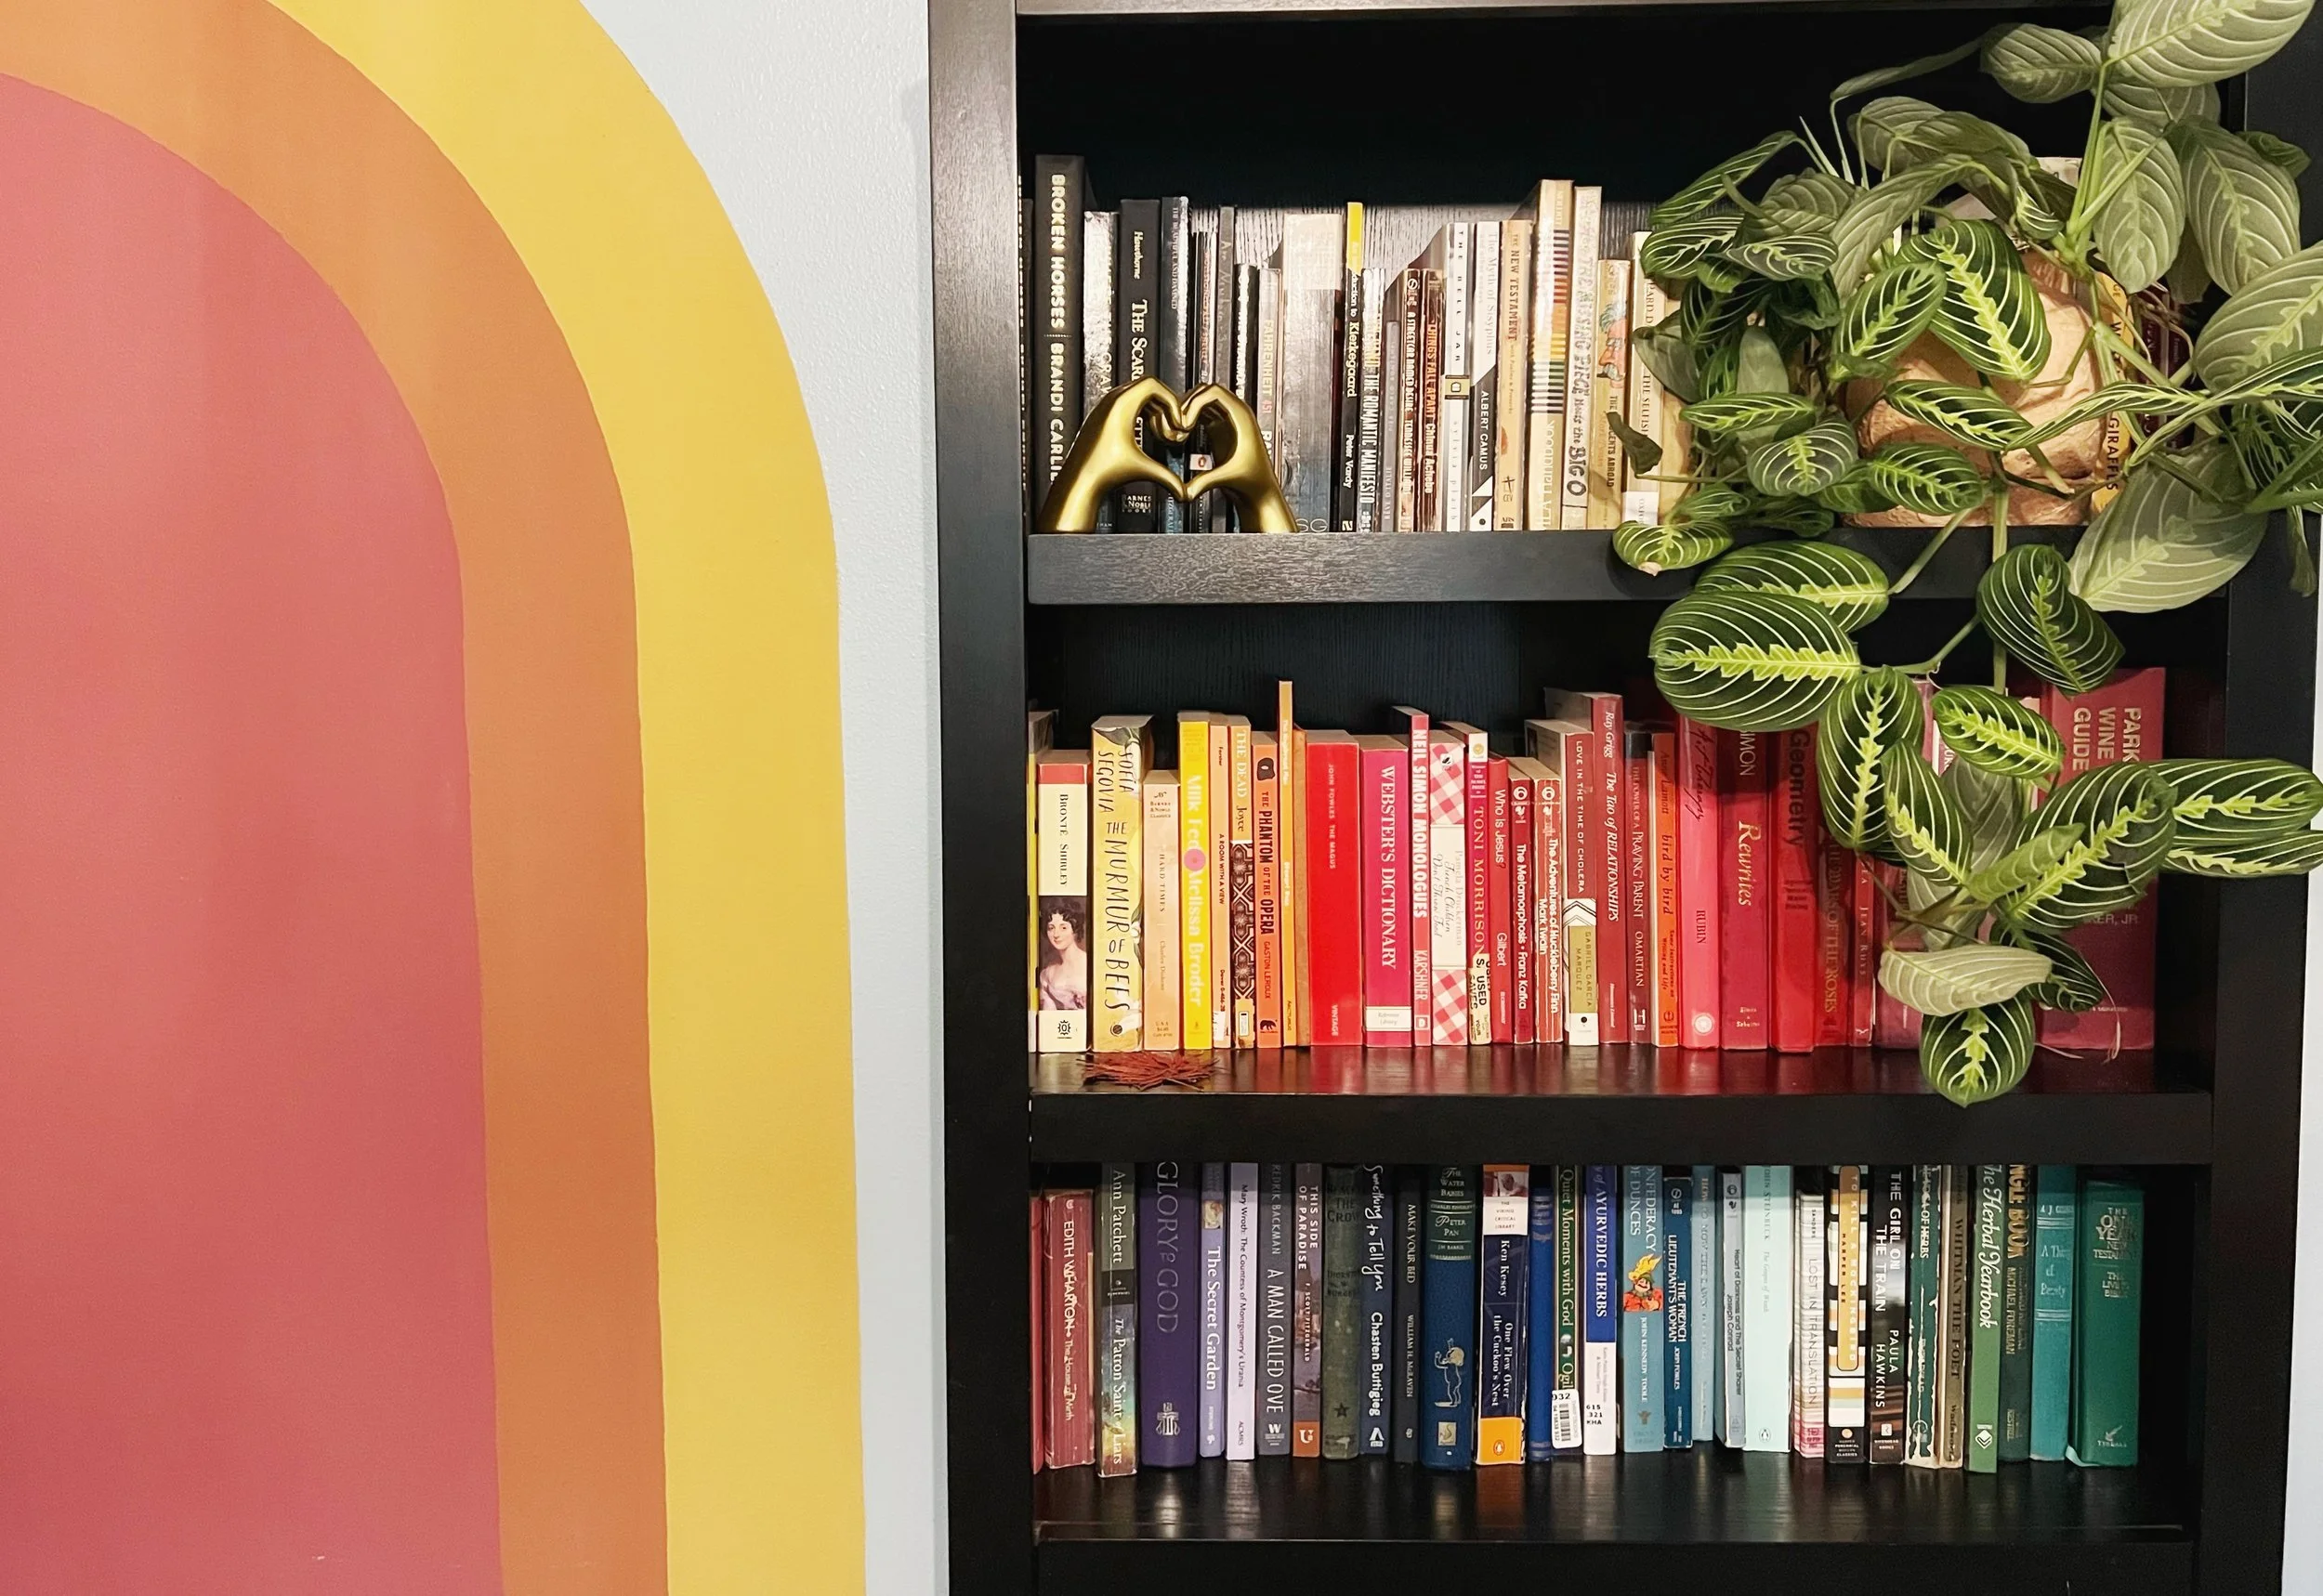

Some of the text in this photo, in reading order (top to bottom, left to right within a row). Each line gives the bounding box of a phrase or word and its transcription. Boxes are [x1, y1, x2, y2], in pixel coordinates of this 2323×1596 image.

[1051, 174, 1066, 252] BROKEN
[1051, 256, 1066, 329] HORSES
[1484, 231, 1498, 355] The Myth of Sisyphus
[1051, 343, 1067, 412] BRANDI
[1262, 319, 1274, 414] FAHRENHEIT 451
[1345, 321, 1358, 398] Kierkegaard
[1344, 434, 1355, 458] Peter
[1478, 390, 1490, 470] ALBERT CAMUS
[1342, 460, 1354, 489] Vardy
[2072, 707, 2091, 771] GUIDE
[2097, 707, 2116, 760] WINE
[1097, 750, 1116, 814] SEGOVIA
[1117, 750, 1135, 794] SOFÍA
[1235, 729, 1248, 832] THE DEAD Joyce
[1783, 731, 1812, 847] Geometry
[1473, 805, 1485, 850] TONI
[1576, 740, 1585, 893] LOVE IN THE TIME OF CHOLERA
[1602, 711, 1620, 922] Ray Grigg The Tao of RELATIONSHIPS
[1186, 775, 1205, 1007] Milk Fed Melissa Broder
[1258, 791, 1275, 1000] THE PHANTOM OF THE OPERA GASTON LEROUX
[1380, 765, 1398, 970] WEBSTER'S DICTIONARY
[1411, 729, 1428, 1001] NEIL SIMON MONOLOGUES KARSHNER
[1454, 850, 1463, 947] Pamela Druckerman
[1737, 820, 1762, 906] Rewrites
[1104, 821, 1131, 1012] THE MURMUR OF BEES
[1473, 857, 1487, 956] MORRISON
[1516, 844, 1529, 1010] The Metamorphosis Franz Kafka
[1695, 909, 1707, 944] RUBIN
[1331, 1004, 1339, 1036] VINTAGE
[1476, 975, 1488, 1006] USED
[1308, 1184, 1319, 1249] THIS SIDE
[1439, 1179, 1465, 1188] WATER
[1440, 1188, 1464, 1197] BABIES
[1560, 1169, 1575, 1205] Quiet
[1297, 1184, 1307, 1270] OF PARADISE
[1406, 1204, 1416, 1284] MAKE YOUR BED
[1435, 1215, 1466, 1228] PETER
[1444, 1228, 1460, 1236] PAN
[1561, 1208, 1575, 1265] Moments
[1888, 1171, 1902, 1271] THE GIRL ON
[1236, 1184, 1249, 1388] Mary Wroth: The Countess of Montgomery's Urania
[1361, 1164, 1385, 1417] Something to Tell You Chasten Buttigieg
[1497, 1239, 1510, 1298] Ken Kesey
[1561, 1268, 1574, 1296] with
[1667, 1234, 1678, 1343] LIEUTENANT'S WOMAN
[1734, 1271, 1742, 1279] of
[1875, 1224, 1888, 1313] THE TRAIN
[1951, 1218, 1964, 1380] WHITMAN THE POET
[1206, 1246, 1221, 1391] The Secret Garden
[1561, 1299, 1574, 1327] God
[1676, 1280, 1687, 1343] THE FRENCH
[1725, 1293, 1735, 1351] Joseph Conrad
[1734, 1315, 1742, 1331] and
[1734, 1332, 1742, 1345] The
[1806, 1259, 1818, 1406] LOST IN TRANSLATION
[1490, 1315, 1503, 1407] the Cuckoo's Nest
[1503, 1323, 1513, 1399] One Flew Over
[1673, 1346, 1682, 1364] JOHN
[1735, 1371, 1743, 1396] Sharer
[1875, 1344, 1886, 1408] HAWKINS
[1889, 1329, 1900, 1374] PAULA
